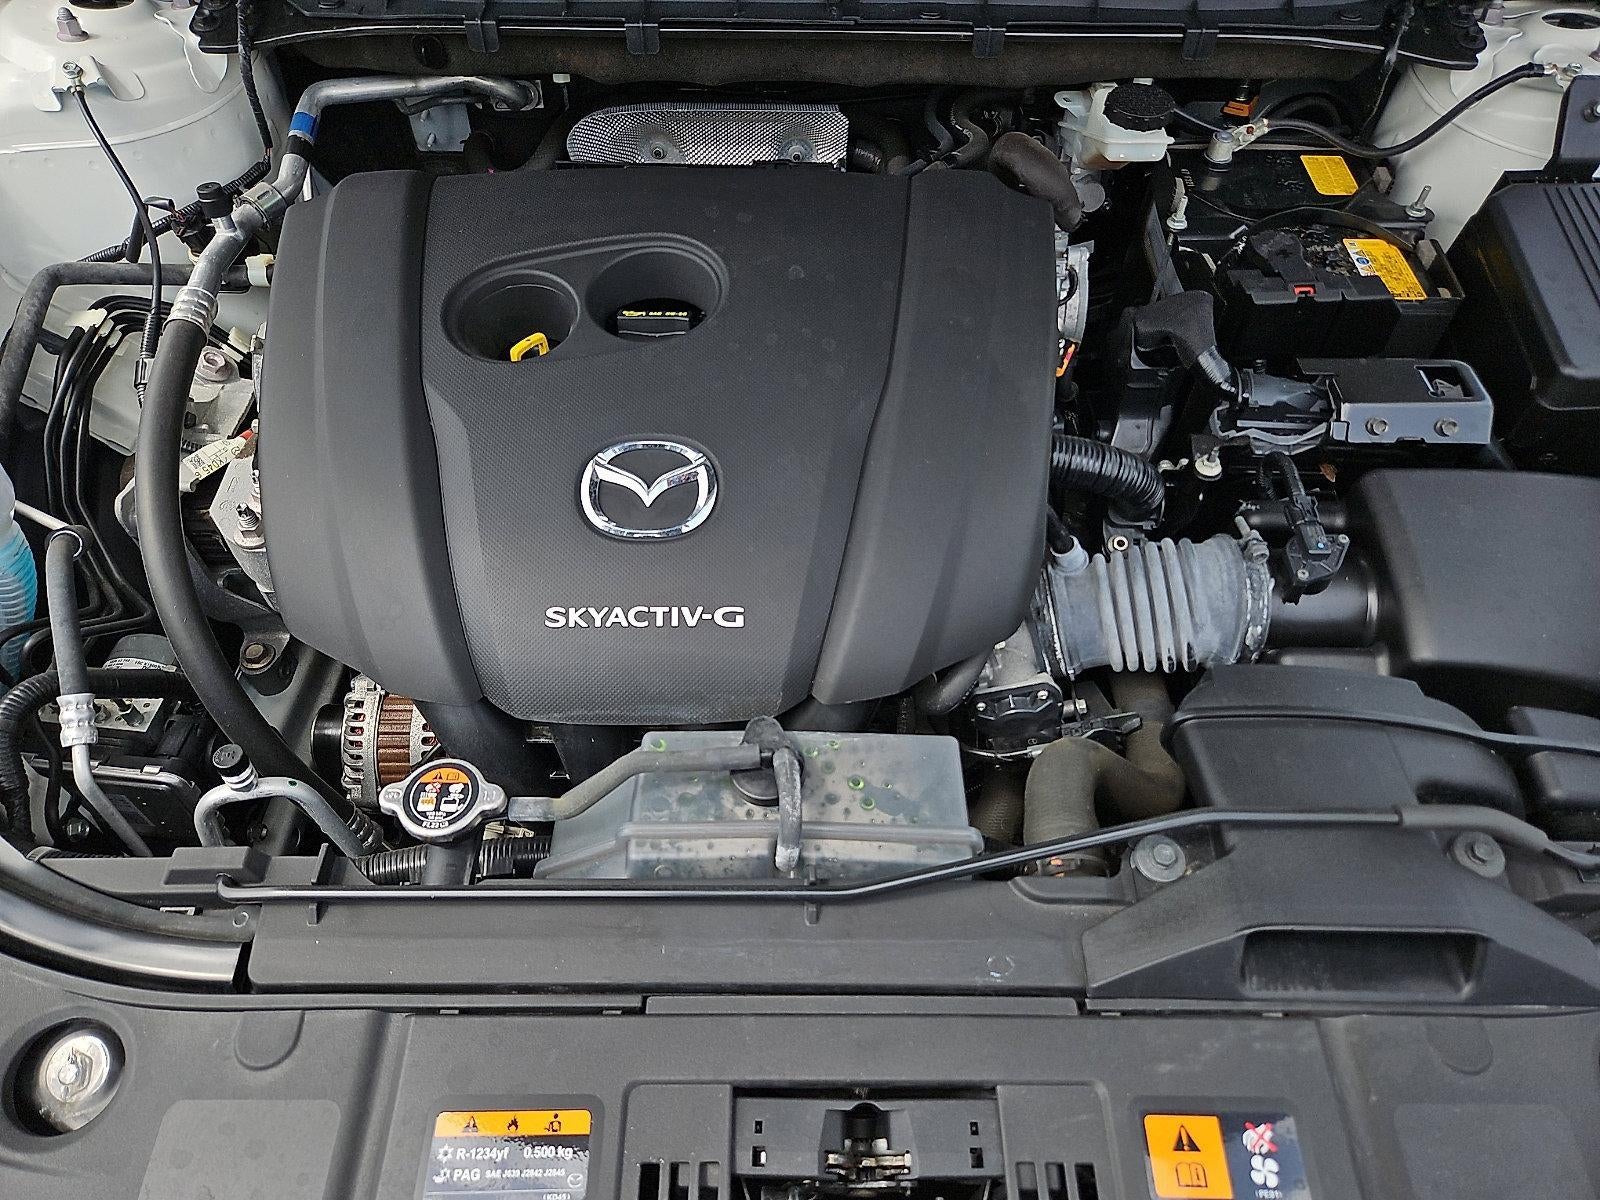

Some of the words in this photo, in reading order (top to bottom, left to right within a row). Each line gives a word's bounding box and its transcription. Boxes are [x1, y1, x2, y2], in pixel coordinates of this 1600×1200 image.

[544, 605, 746, 629] SKYACTIV-G
[456, 1146, 510, 1162] R-1234yf
[523, 1146, 556, 1159] 0.500
[557, 1146, 574, 1160] kg
[452, 1168, 481, 1182] PAG
